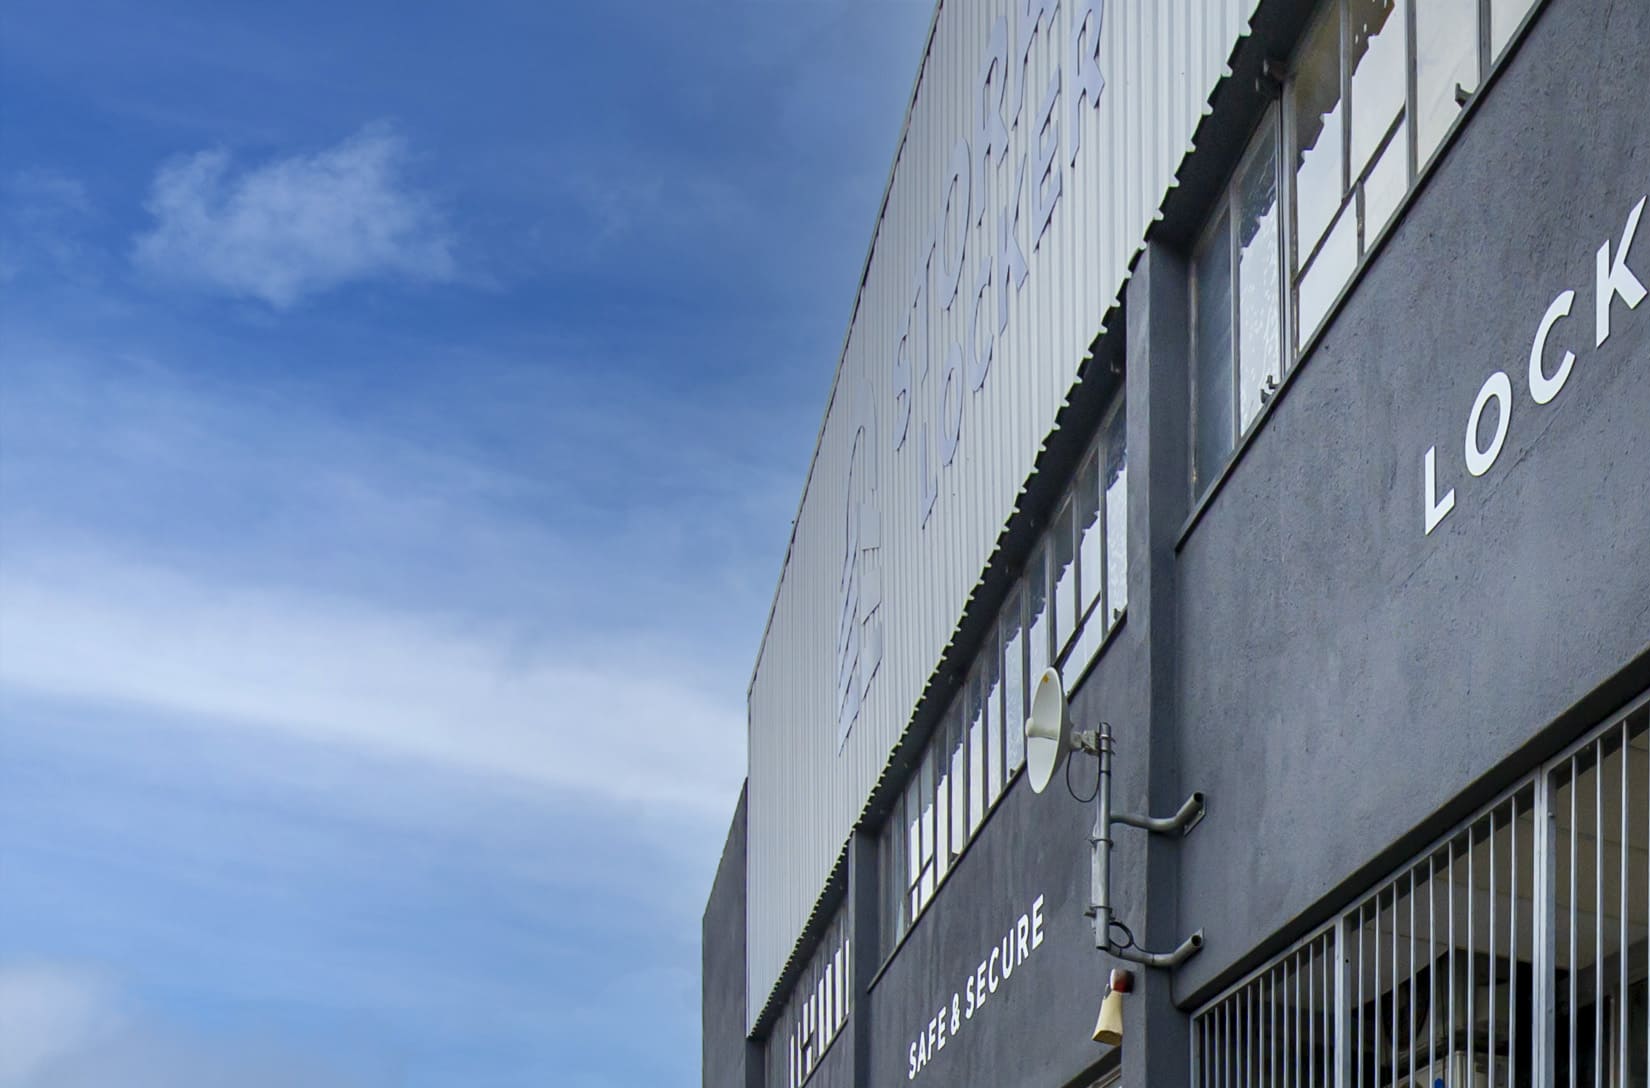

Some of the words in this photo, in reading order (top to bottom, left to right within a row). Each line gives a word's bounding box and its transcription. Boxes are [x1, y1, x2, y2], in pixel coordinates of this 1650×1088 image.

[1424, 194, 1648, 535] LOCK
[908, 1006, 947, 1080] SAFE
[951, 992, 960, 1036] &
[965, 893, 1044, 1020] SECURE
